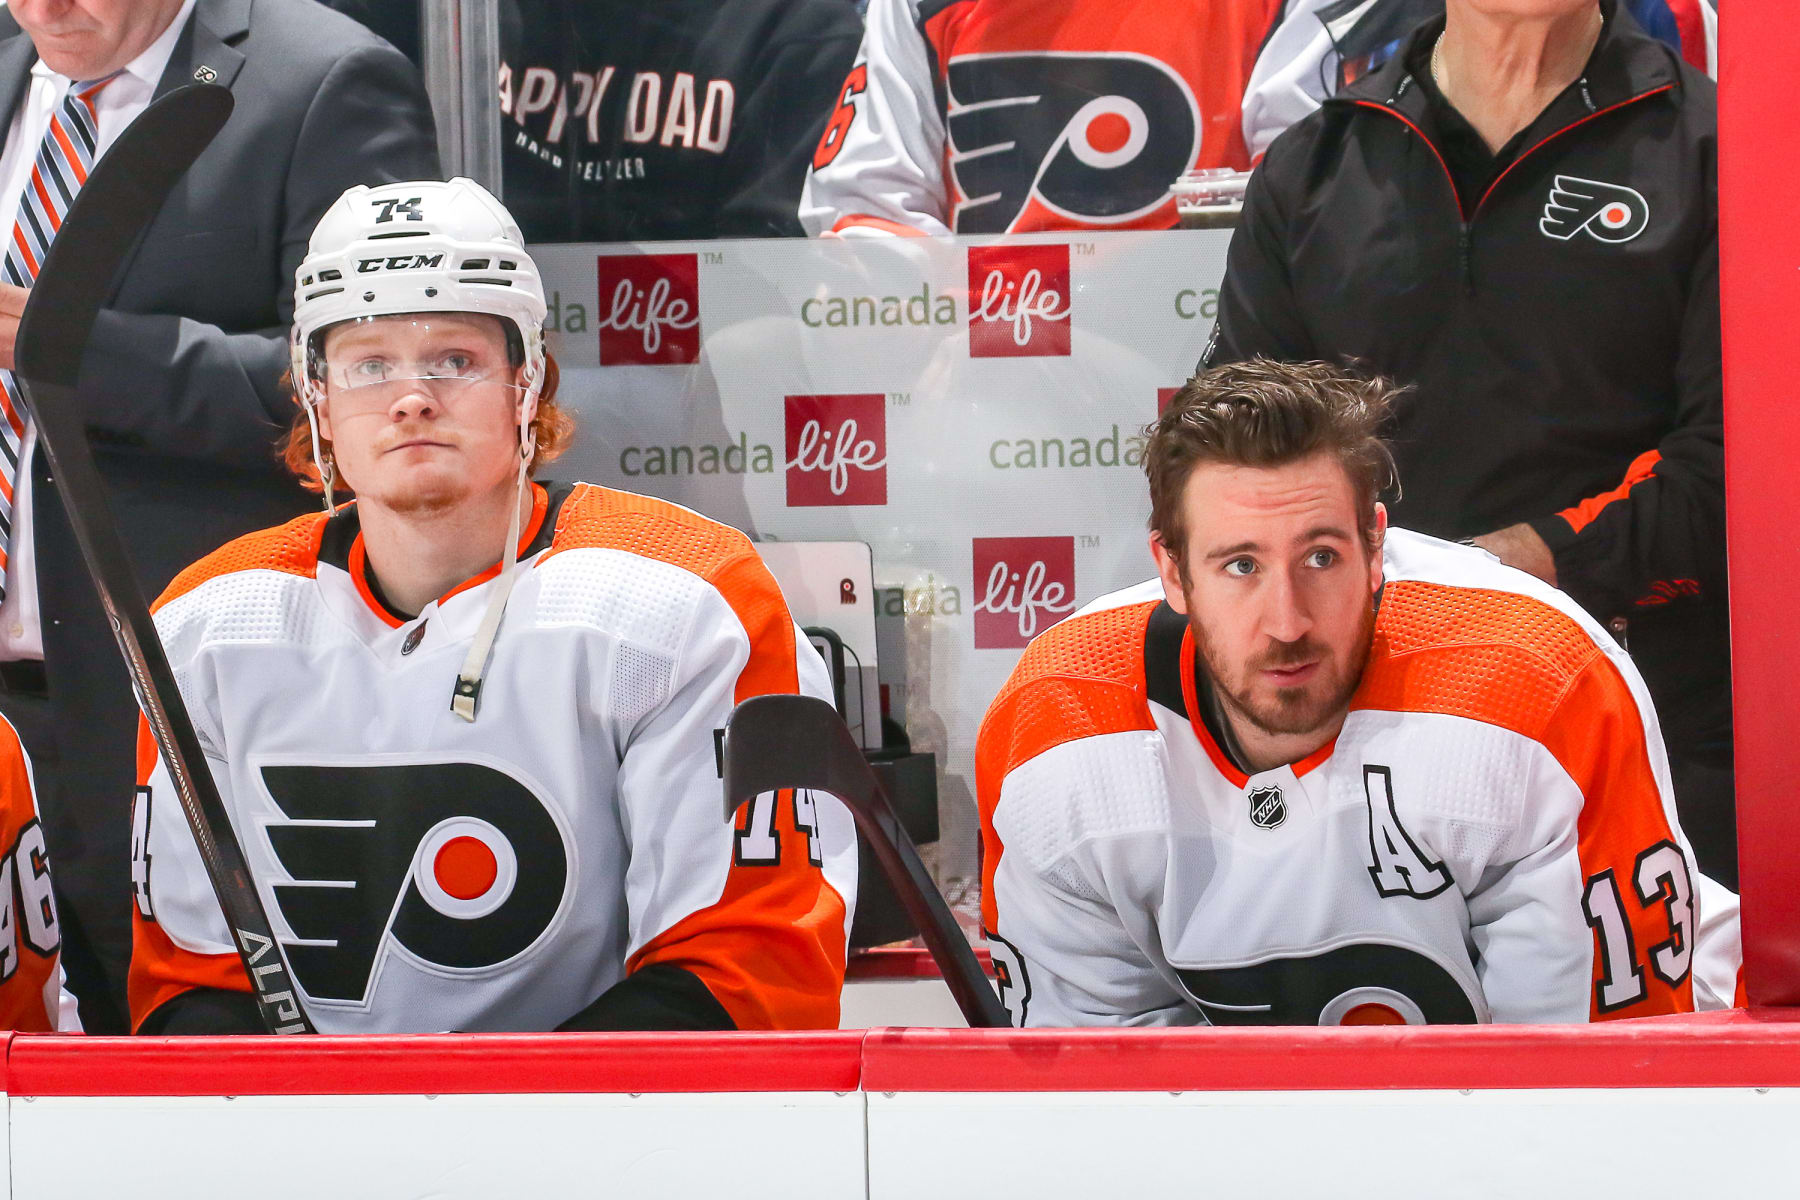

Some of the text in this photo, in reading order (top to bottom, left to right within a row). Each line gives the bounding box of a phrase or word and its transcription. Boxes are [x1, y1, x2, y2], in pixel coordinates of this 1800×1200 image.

[624, 71, 735, 154] DAD
[371, 197, 423, 224] 74
[357, 253, 444, 273] CCM
[598, 278, 700, 354] life
[801, 282, 957, 328] canada
[969, 268, 1071, 346] life
[620, 431, 774, 477] canada
[785, 418, 887, 495] life
[989, 424, 1150, 469] canada
[974, 560, 1076, 638] life
[1257, 794, 1280, 823] NHL
[1363, 763, 1456, 900] A
[1581, 839, 1694, 1014] 13
